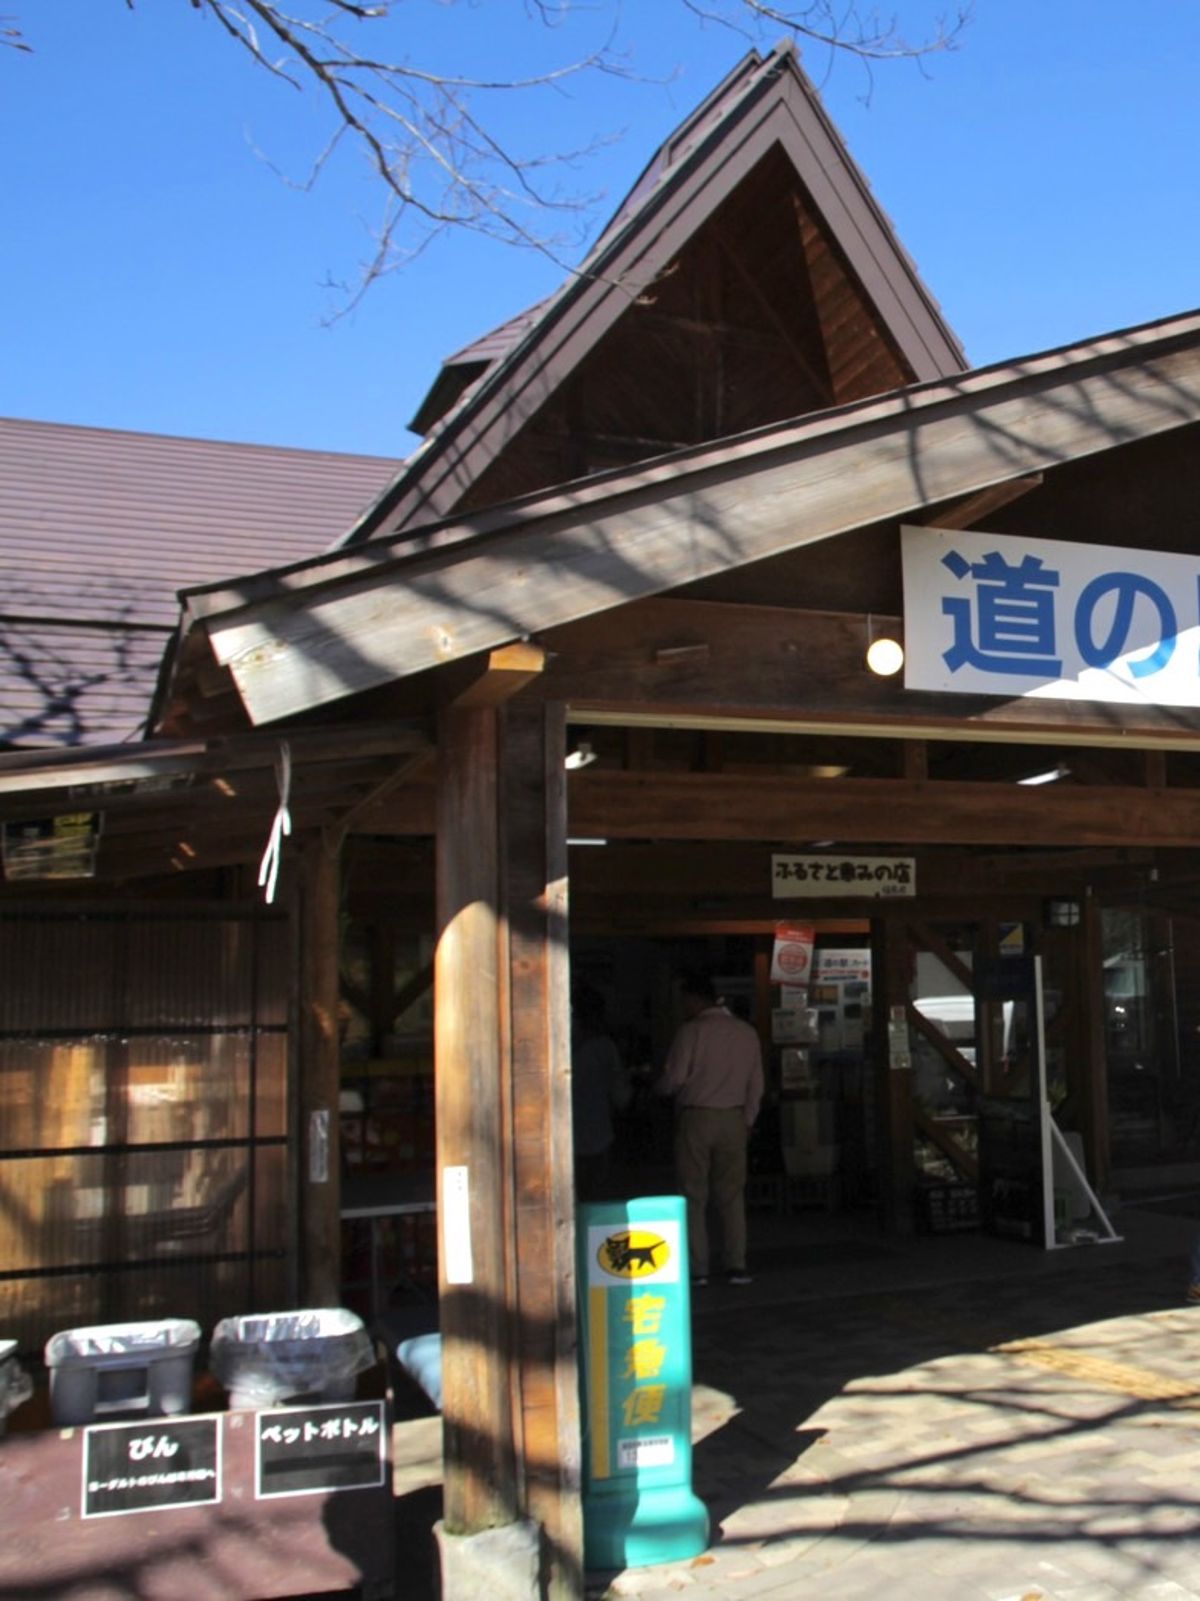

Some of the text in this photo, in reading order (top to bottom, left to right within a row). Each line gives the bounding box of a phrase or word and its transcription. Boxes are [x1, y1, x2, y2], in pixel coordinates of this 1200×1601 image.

[261, 1416, 380, 1444] ペットボトル
[128, 1435, 179, 1460] びん
